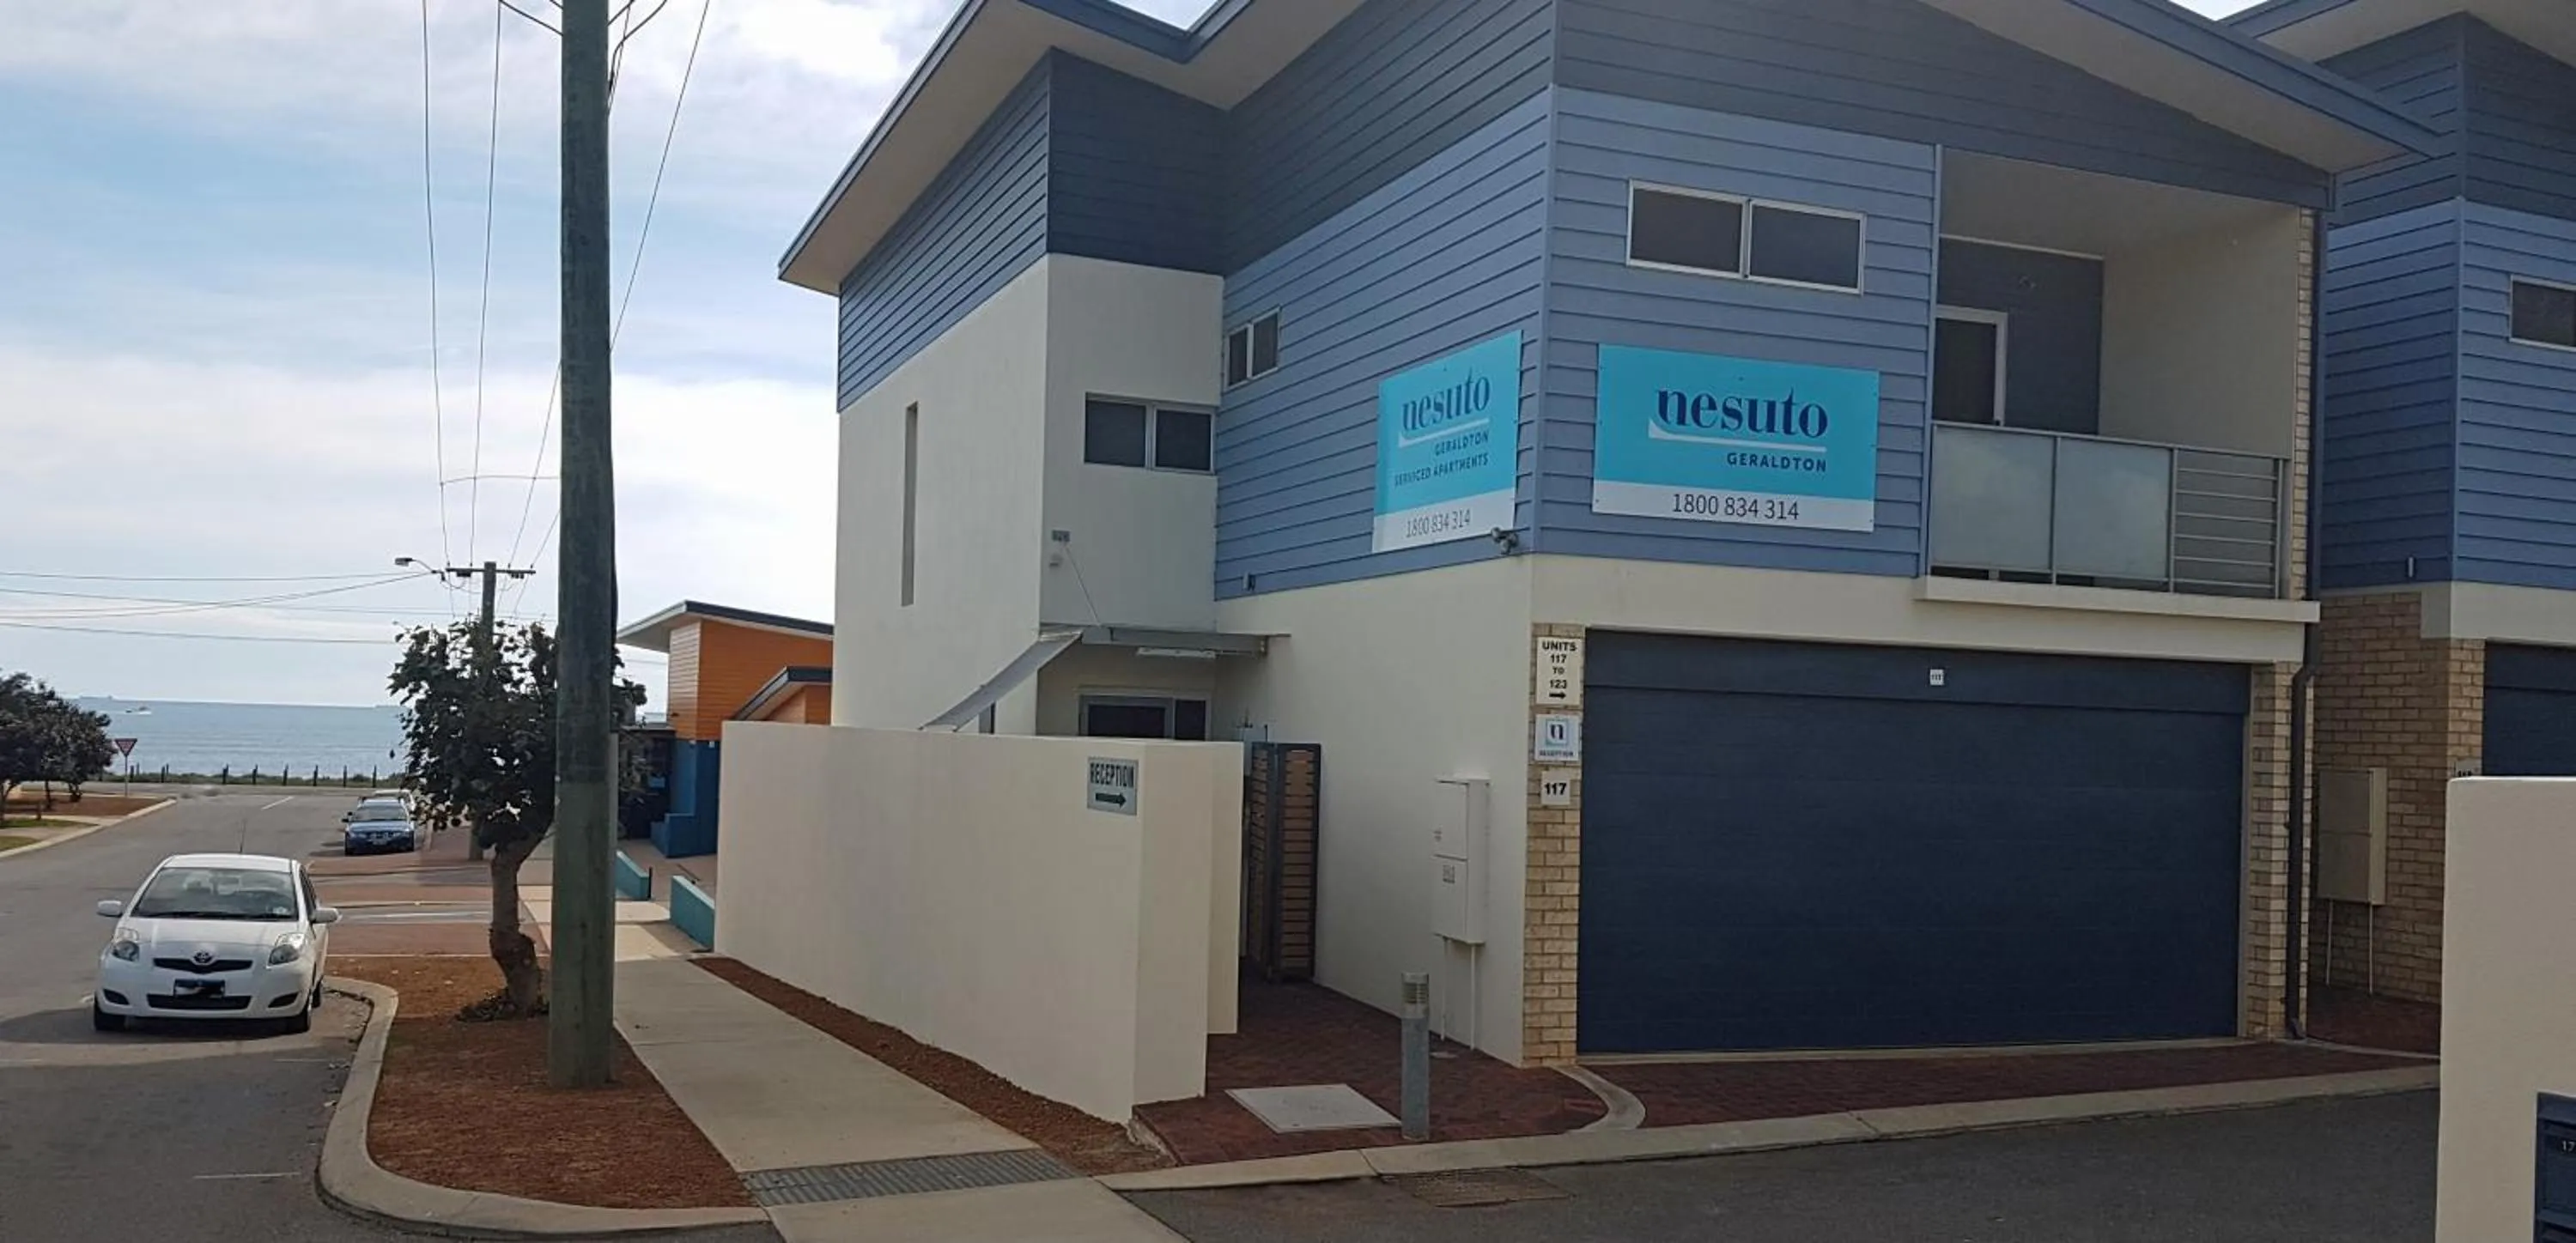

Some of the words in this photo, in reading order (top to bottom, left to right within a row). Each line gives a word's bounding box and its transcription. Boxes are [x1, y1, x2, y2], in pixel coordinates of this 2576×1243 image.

[1401, 368, 1491, 431] nesuto
[1656, 386, 1828, 438] nesuto
[1435, 430, 1489, 457] GERALDTON
[1394, 466, 1431, 487] SERVICED
[1433, 452, 1489, 477] APARTMENTS
[1727, 452, 1826, 472] GERALDTON
[1672, 494, 1718, 516] 1800
[1724, 497, 1759, 518] 834
[1763, 500, 1799, 521] 314
[1406, 515, 1431, 538] 1800
[1431, 512, 1449, 533] 834
[1452, 508, 1471, 531] 314
[1542, 640, 1577, 652] UNITS
[1551, 654, 1567, 664] 117
[1552, 666, 1565, 675] TO
[1550, 679, 1567, 689] 123
[1090, 762, 1134, 788] RECEPTION
[1544, 782, 1568, 796] 117
